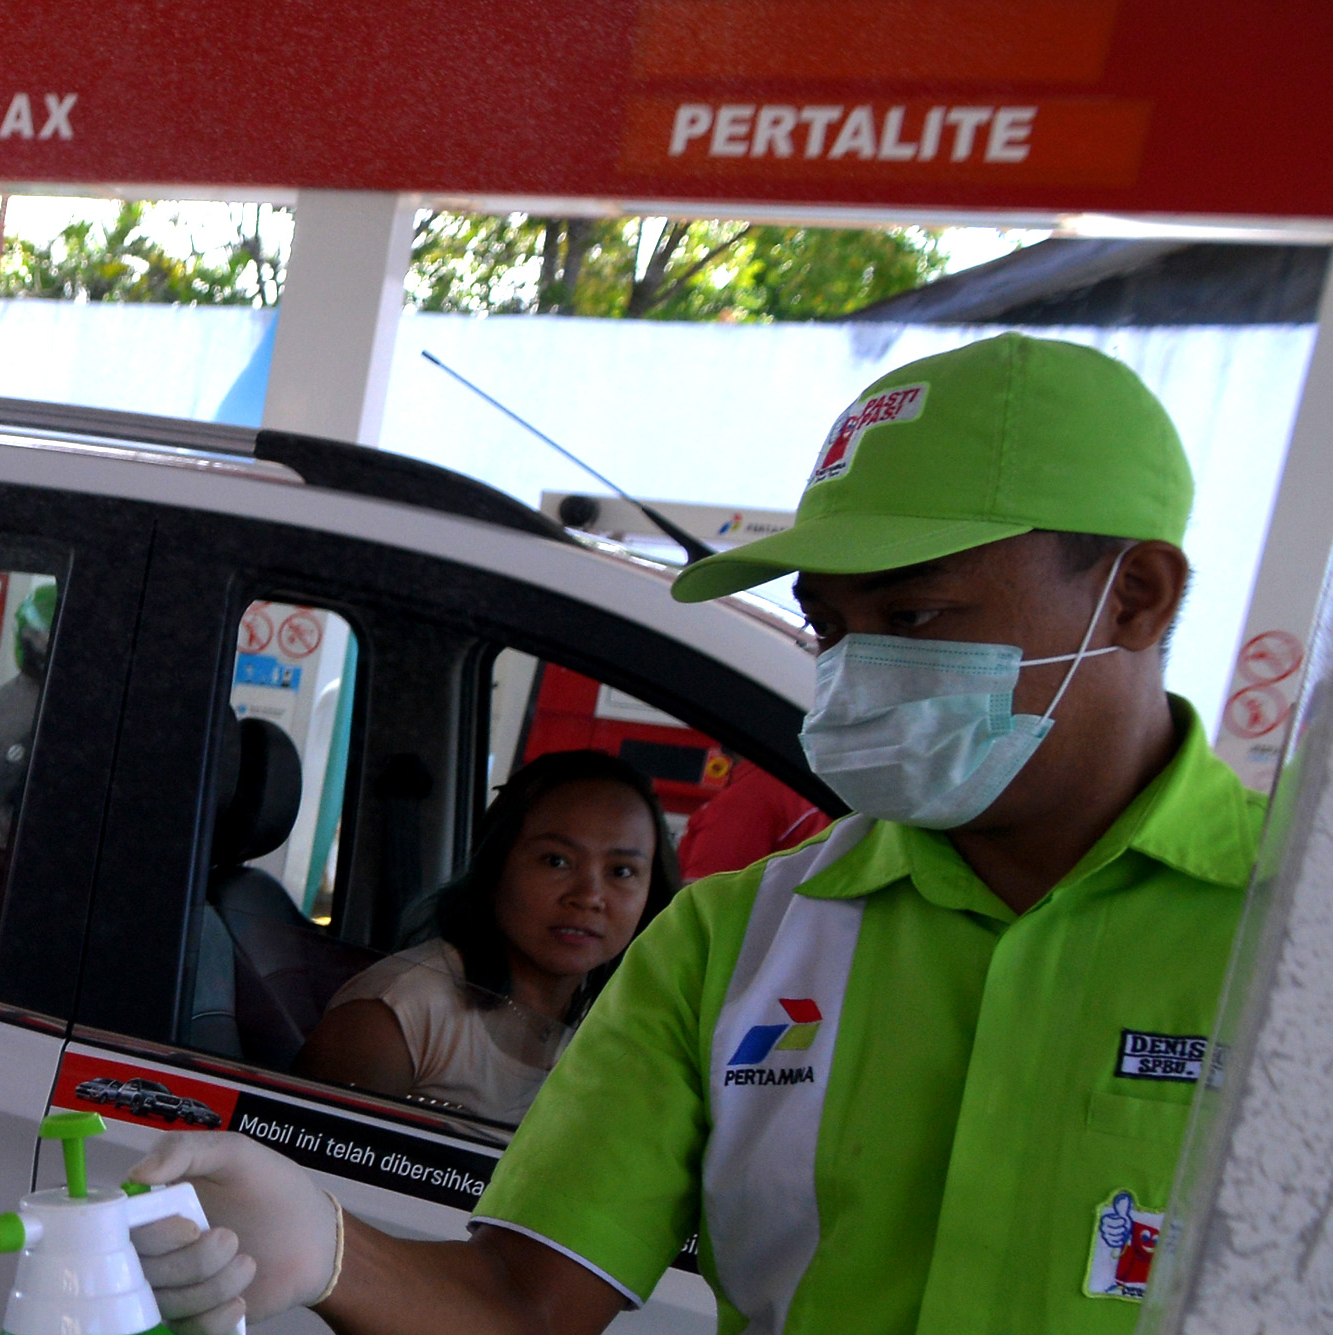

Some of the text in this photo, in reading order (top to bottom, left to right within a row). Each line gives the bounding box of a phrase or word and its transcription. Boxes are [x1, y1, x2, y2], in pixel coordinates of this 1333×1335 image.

[667, 102, 1038, 163] PERTALITE
[862, 388, 921, 416] PASTI
[1131, 1036, 1206, 1059] DENIS
[238, 1113, 485, 1197] Mobil ini telah dibersihka
